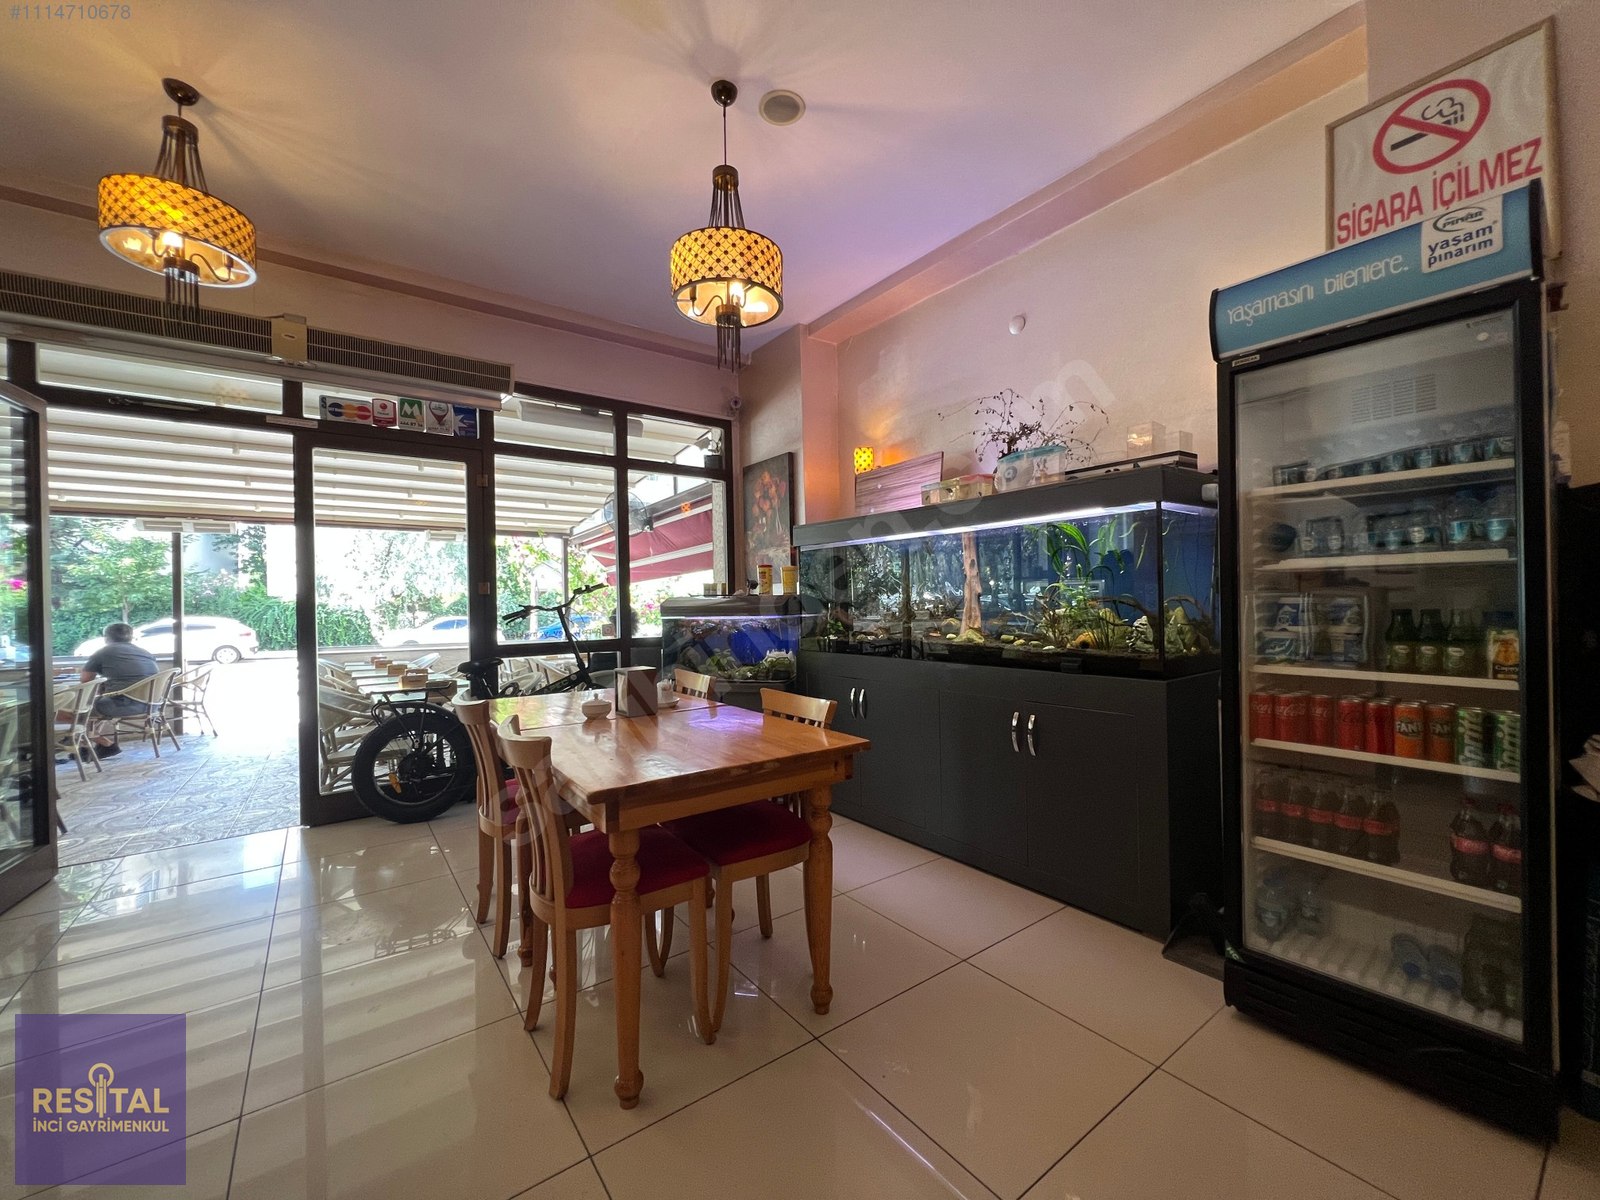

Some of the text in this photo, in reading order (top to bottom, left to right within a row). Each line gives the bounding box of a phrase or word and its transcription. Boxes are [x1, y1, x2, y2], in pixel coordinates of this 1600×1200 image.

[1336, 136, 1543, 245] SİGARA İÇİLMEZ
[1428, 225, 1493, 257] yaşam
[1428, 238, 1493, 268] pınarım
